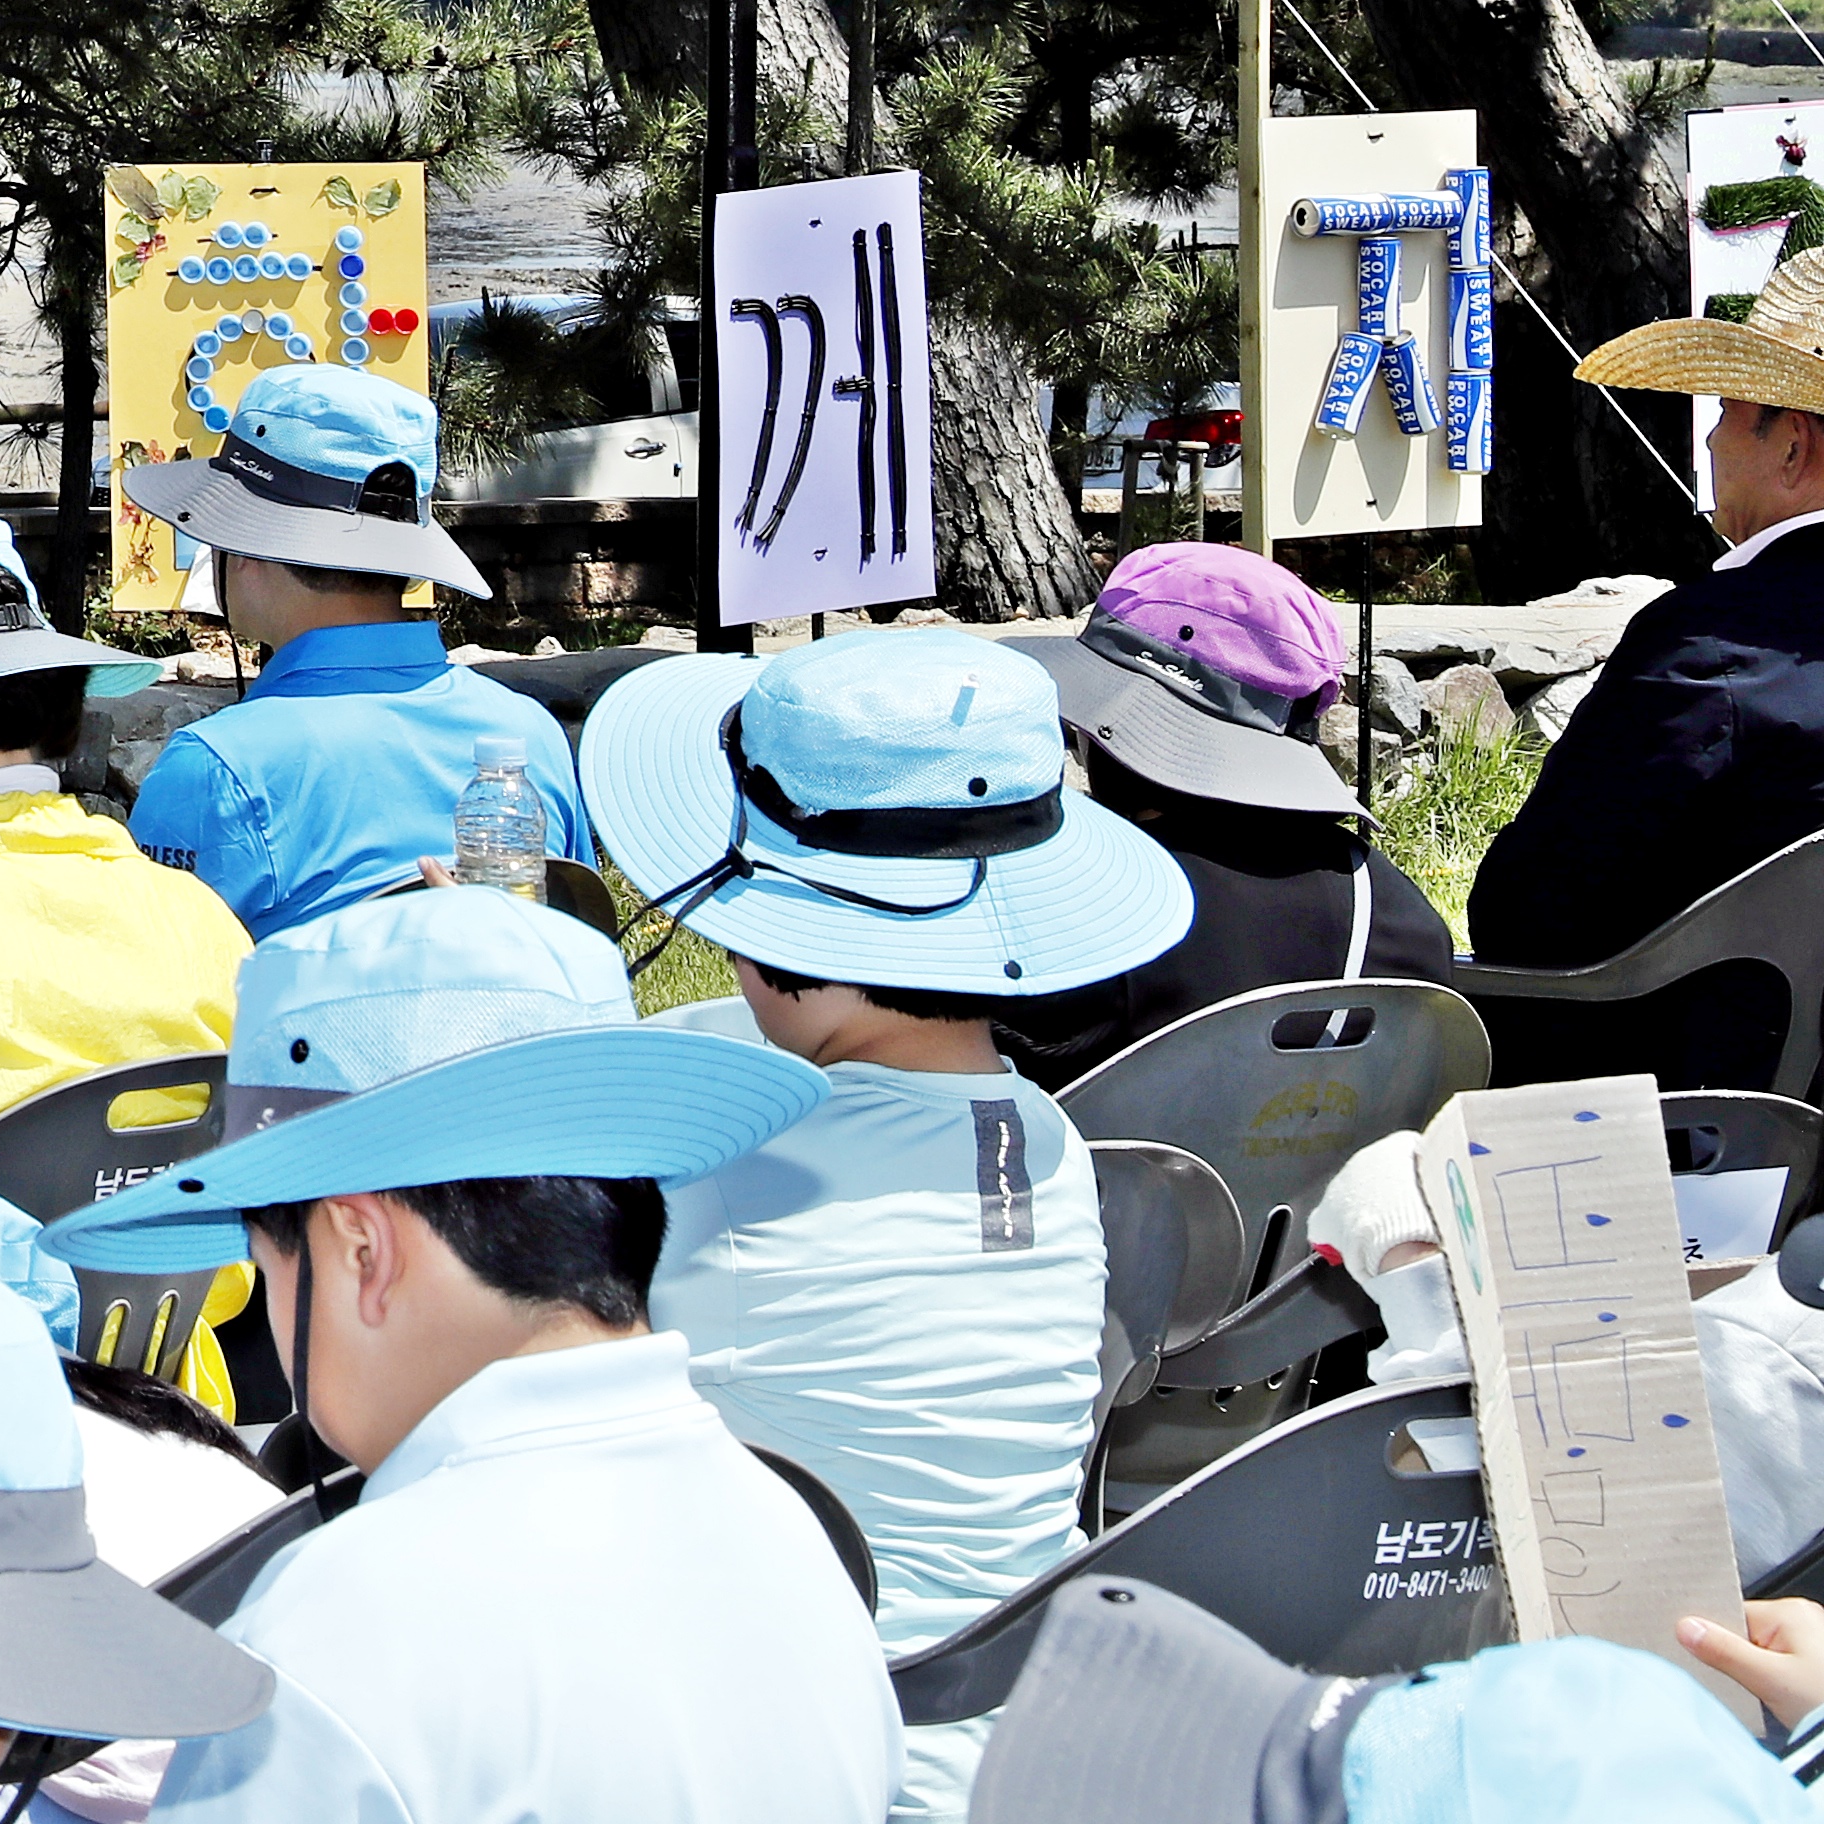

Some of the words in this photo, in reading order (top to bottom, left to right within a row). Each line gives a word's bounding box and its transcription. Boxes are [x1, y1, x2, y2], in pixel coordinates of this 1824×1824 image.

[1322, 202, 1390, 220] POCARI
[1323, 214, 1383, 230] SWEAT
[1396, 213, 1455, 228] SWEAT
[1397, 201, 1462, 216] POCARI
[1359, 246, 1372, 324] SWEAT
[1370, 245, 1385, 334] POCARI
[1468, 278, 1483, 357] SWEAT
[1324, 338, 1356, 413] SWEAT
[1331, 340, 1369, 425] POCARI
[1384, 354, 1421, 433] POCARI
[1453, 380, 1467, 468] POCARI
[1363, 1564, 1493, 1600] 010-8471-3400
